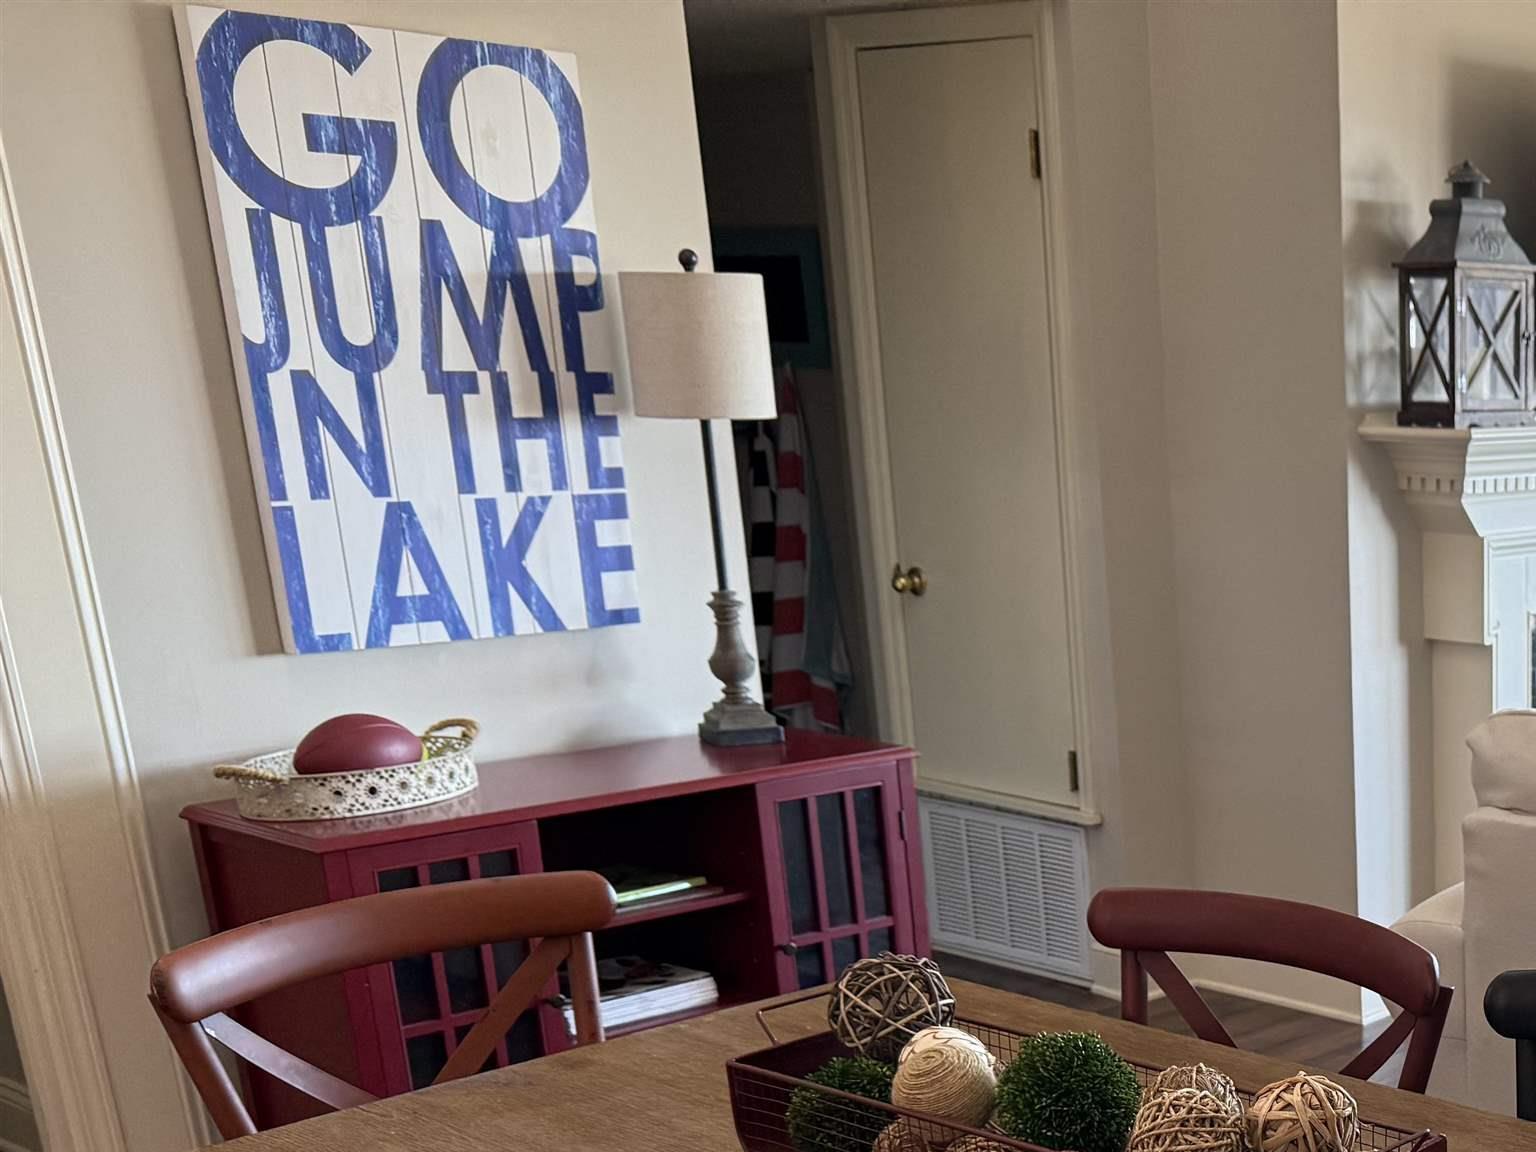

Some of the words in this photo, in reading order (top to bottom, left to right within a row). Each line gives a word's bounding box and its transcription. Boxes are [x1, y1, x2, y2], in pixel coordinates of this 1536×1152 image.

[197, 9, 591, 238] GO
[242, 207, 605, 375] JUMP
[246, 369, 393, 501] IN
[426, 370, 625, 495] THE
[271, 492, 641, 656] LAKE
